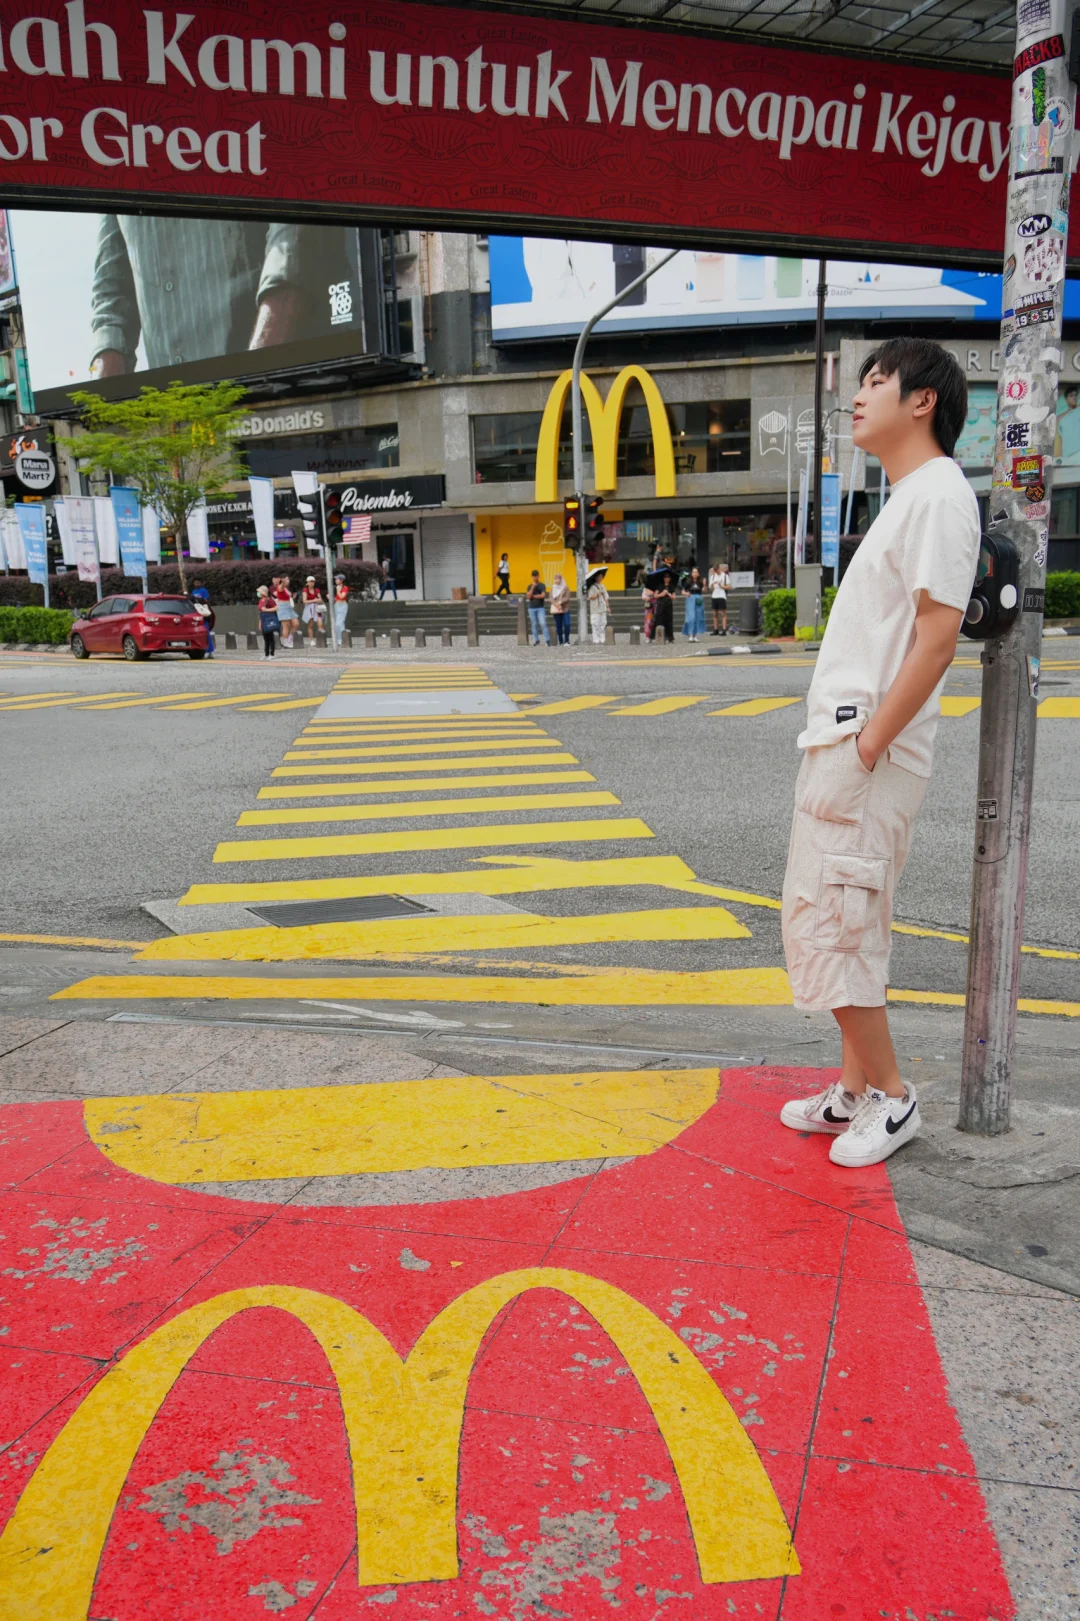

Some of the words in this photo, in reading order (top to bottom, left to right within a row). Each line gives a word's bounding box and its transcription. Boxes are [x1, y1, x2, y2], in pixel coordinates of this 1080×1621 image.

[142, 9, 347, 100] Kami
[368, 45, 573, 121] untuk
[585, 56, 863, 160] Mencapai
[872, 91, 1012, 181] Kejay
[80, 107, 267, 176] Great
[47, 151, 89, 168] astern
[328, 174, 359, 187] Great
[363, 174, 402, 190] Eastern
[470, 185, 499, 197] Great
[502, 185, 538, 201] Eastern
[599, 194, 626, 206] Great
[629, 195, 661, 209] Eastern
[717, 204, 741, 216] Great
[743, 204, 773, 218] Eastern
[23, 459, 48, 469] Mana
[23, 472, 50, 480] Mart?
[227, 502, 253, 512] EXCHA
[341, 487, 413, 513] Pasembor
